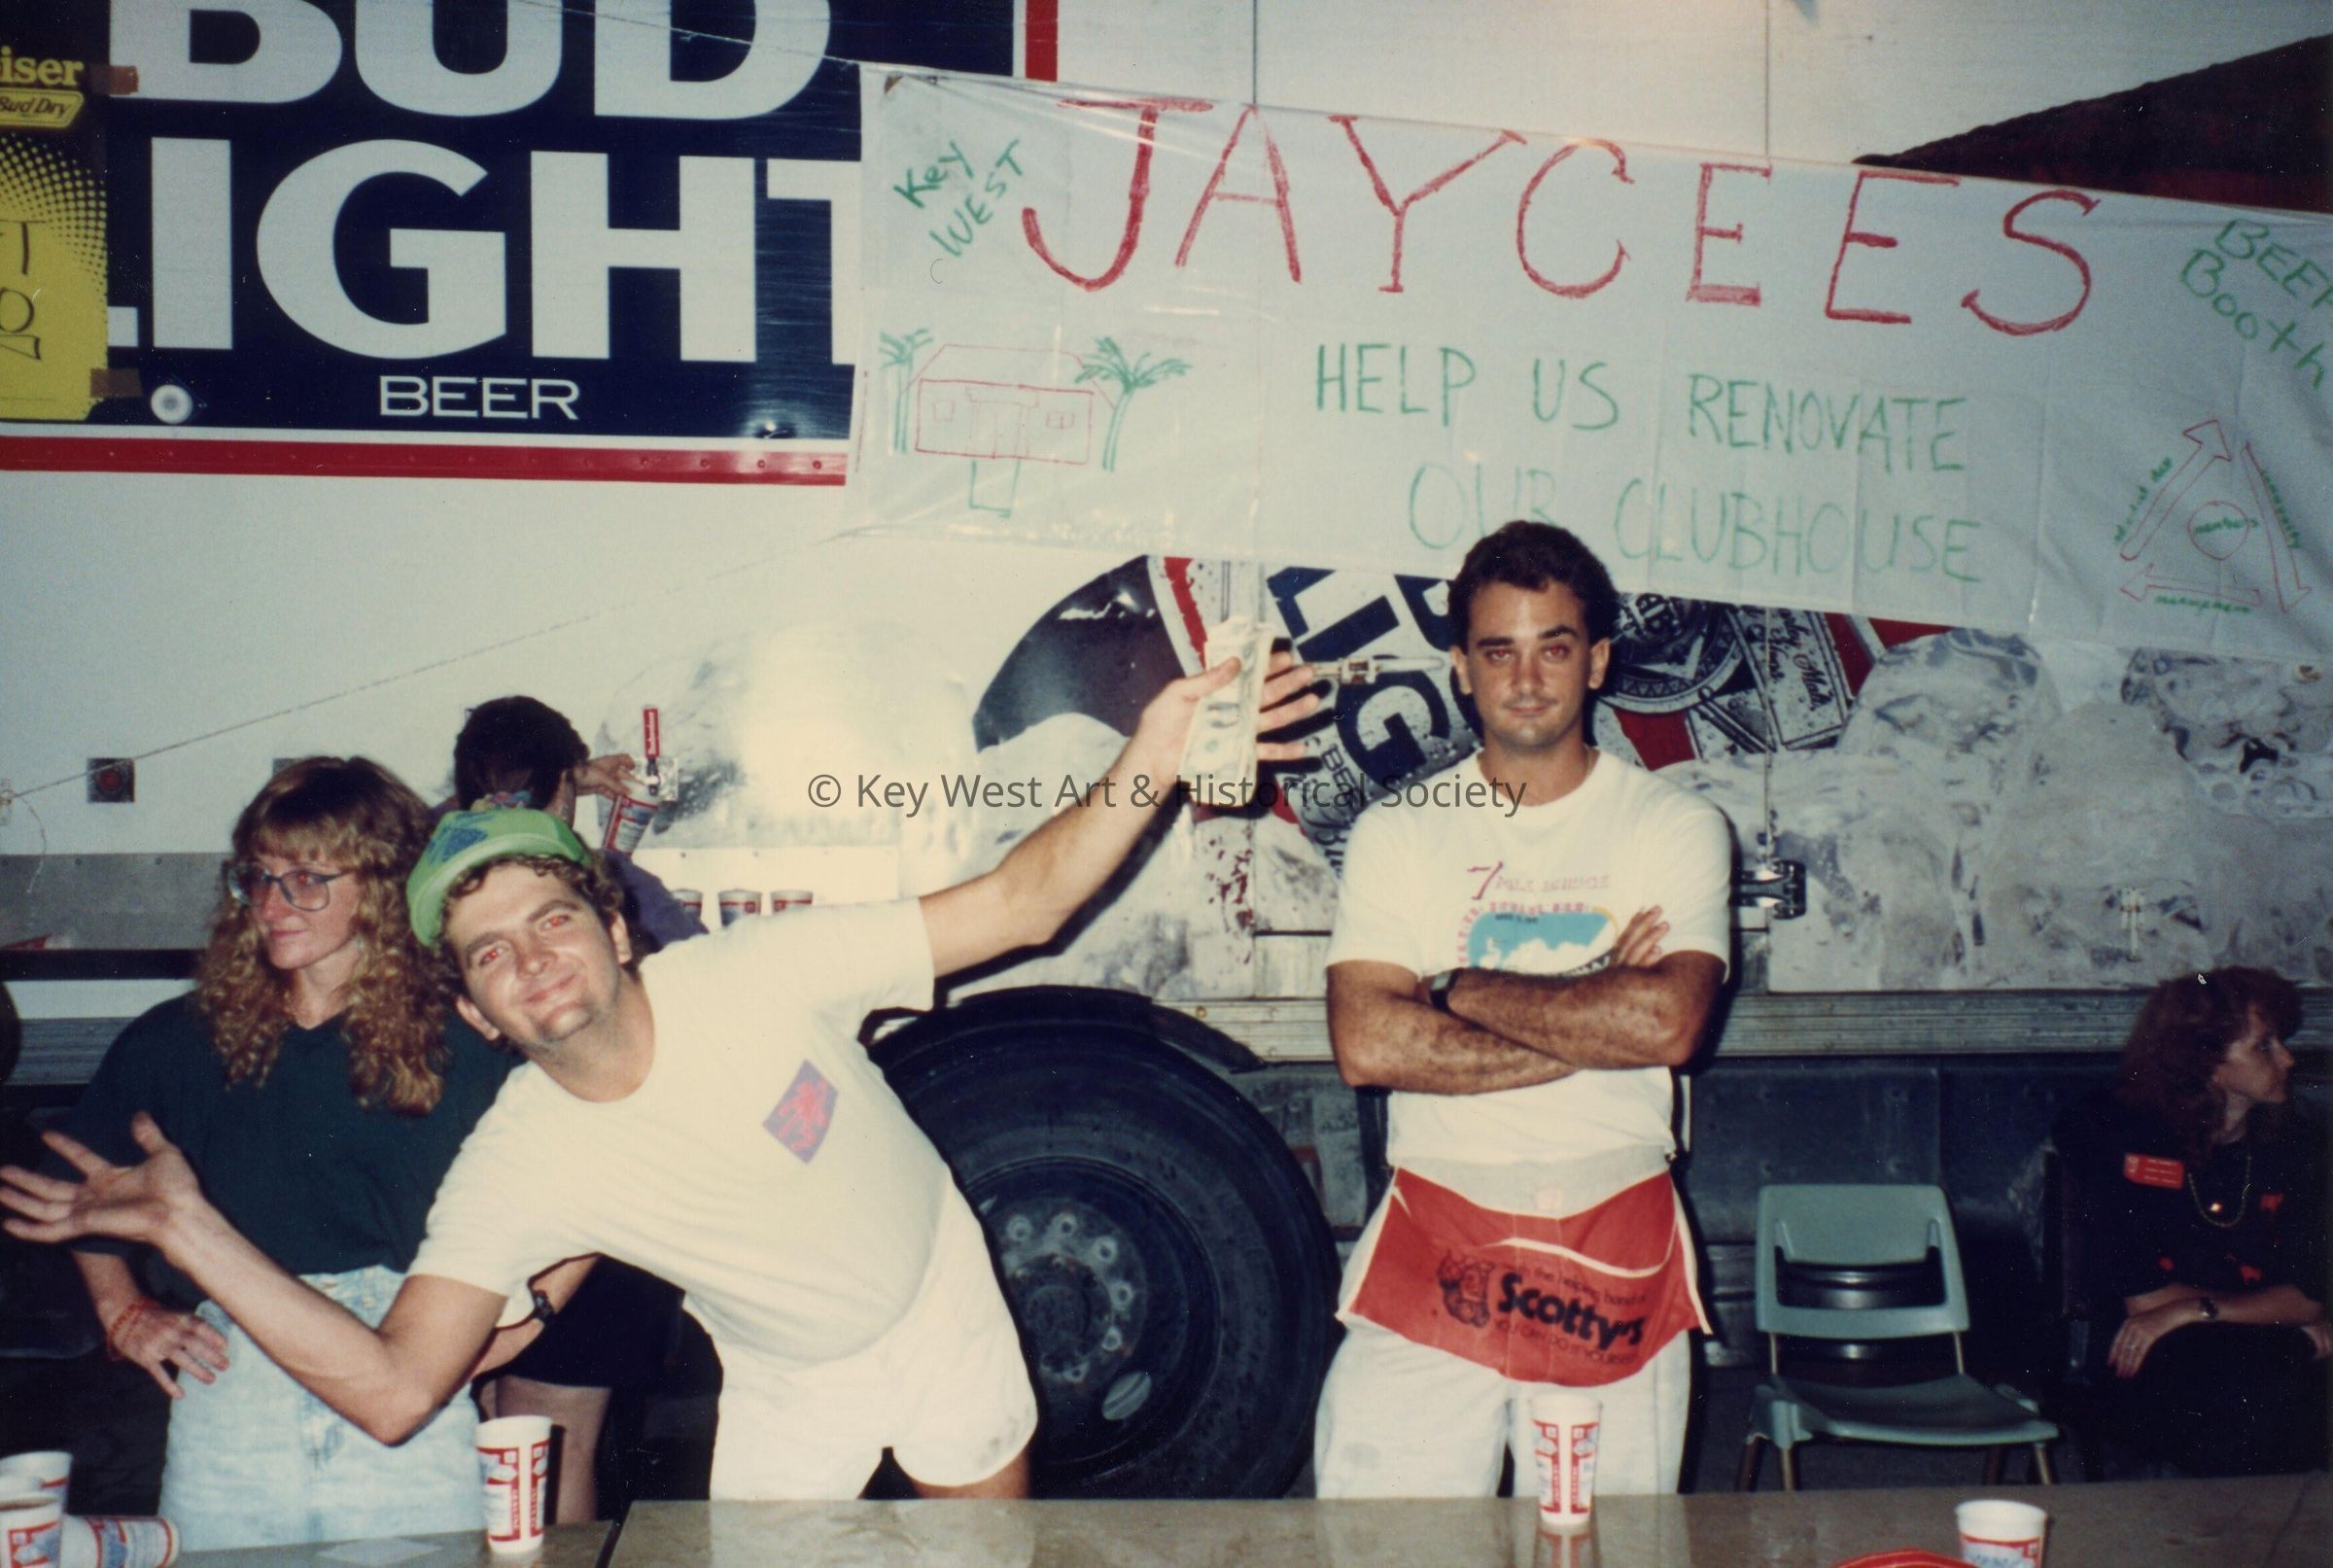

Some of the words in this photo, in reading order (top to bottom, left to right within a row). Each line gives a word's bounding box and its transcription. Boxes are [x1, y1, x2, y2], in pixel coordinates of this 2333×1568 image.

[0, 46, 85, 86] iser
[892, 139, 975, 209] Key
[928, 138, 1021, 259] WEST
[1021, 97, 2102, 336] JAYCEES
[109, 138, 862, 365] IGH
[2179, 248, 2326, 390] Booth
[380, 374, 580, 420] BEER
[1315, 343, 1477, 428] HELP
[1533, 360, 1619, 432] US
[1688, 373, 1968, 473] RENOVATE
[1409, 463, 1557, 549] OUR
[1614, 476, 1983, 583] CLUBHOUSE
[1467, 860, 1504, 900] 7
